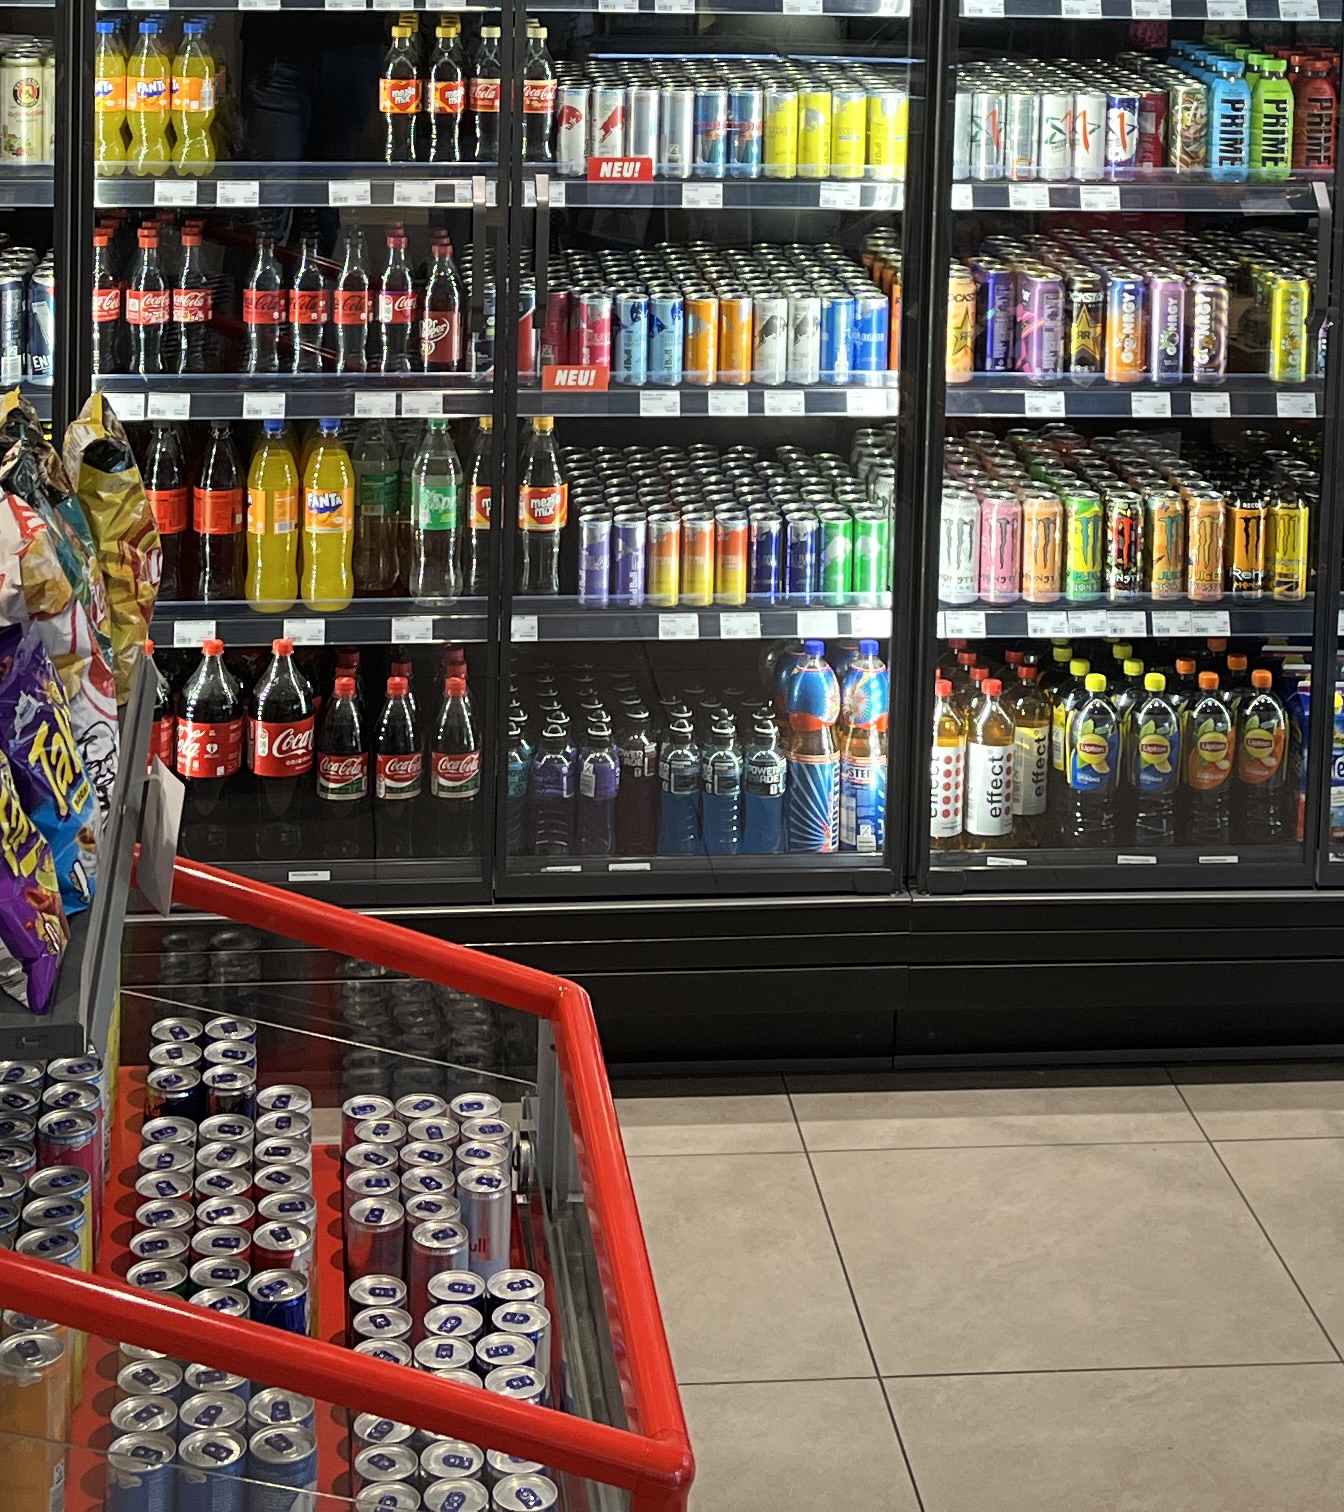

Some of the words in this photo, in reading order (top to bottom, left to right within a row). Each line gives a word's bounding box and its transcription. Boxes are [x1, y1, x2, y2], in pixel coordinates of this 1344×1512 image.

[1218, 97, 1246, 168] PRIME
[1260, 97, 1290, 168] PRIME
[1304, 96, 1334, 168] PRIME
[599, 160, 642, 179] NEU!
[554, 369, 596, 387] NEU!
[1078, 743, 1109, 754] Lipton
[1140, 743, 1168, 754] Lipton
[1199, 741, 1227, 752] Lipton
[1245, 738, 1273, 749] Lipton
[319, 757, 363, 776] Coca-Cola
[437, 756, 480, 776] Coca-Cola
[1034, 733, 1048, 798] effect
[990, 754, 1004, 820] effect
